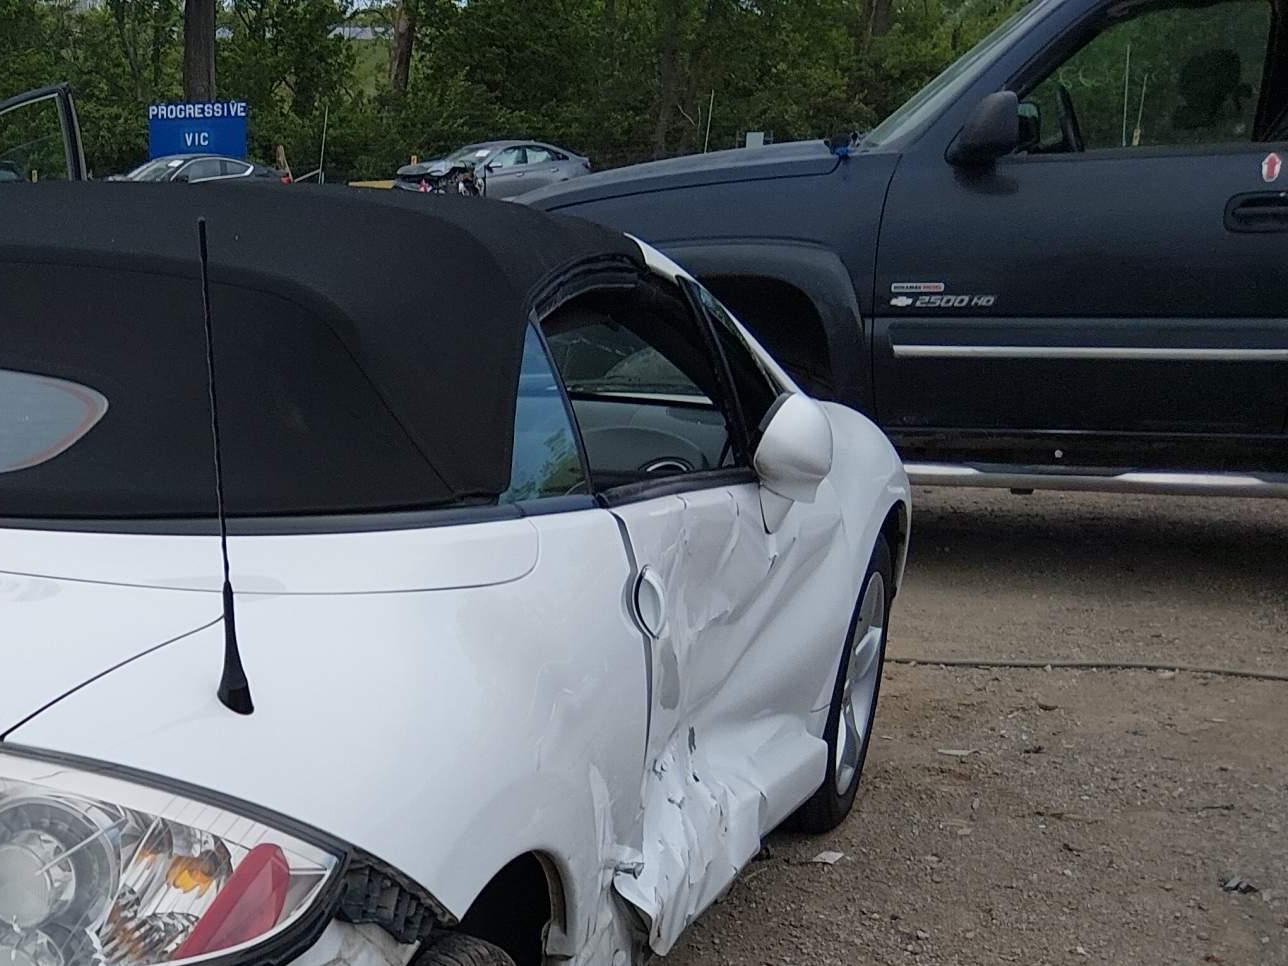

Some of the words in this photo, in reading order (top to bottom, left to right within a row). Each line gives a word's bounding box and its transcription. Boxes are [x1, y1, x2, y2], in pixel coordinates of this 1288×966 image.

[149, 102, 247, 119] PROGRESSIVE
[184, 132, 209, 147] VIC
[915, 295, 969, 307] 2500
